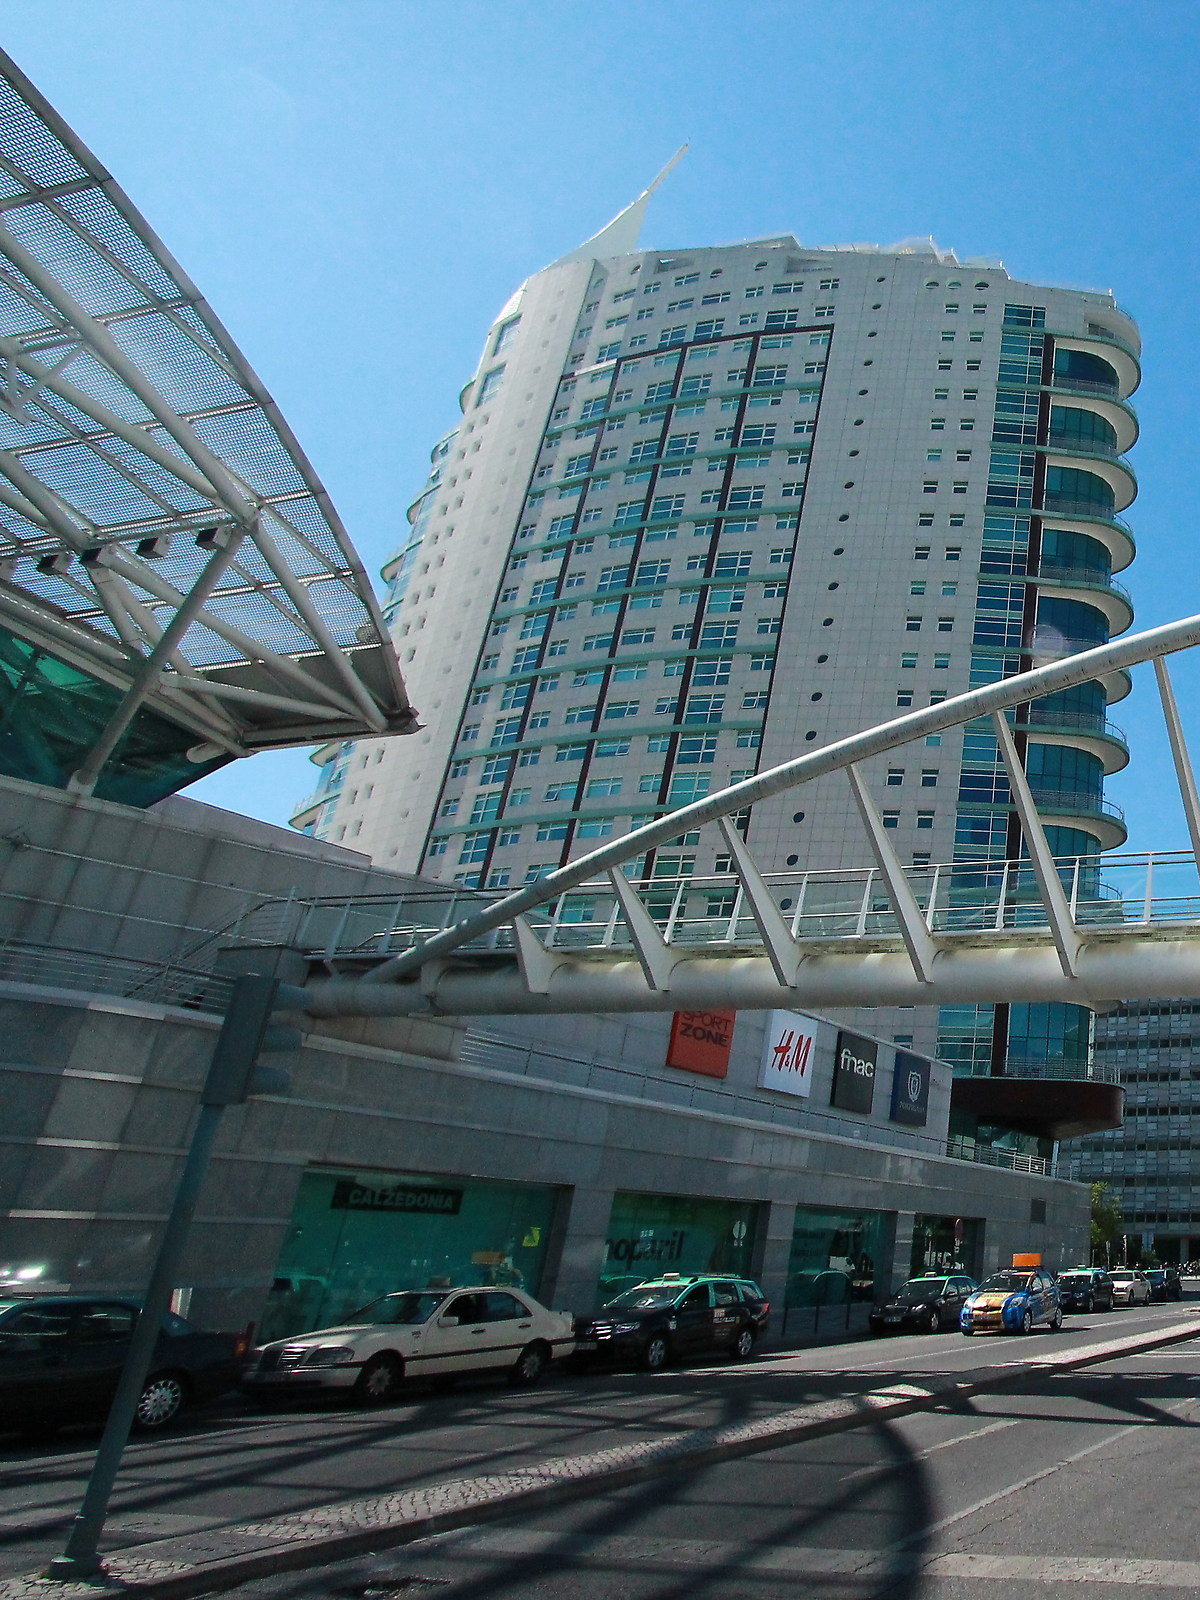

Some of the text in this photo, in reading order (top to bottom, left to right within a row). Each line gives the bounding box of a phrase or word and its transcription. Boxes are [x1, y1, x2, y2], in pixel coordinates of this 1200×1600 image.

[680, 1022, 729, 1048] ZONE
[772, 1028, 812, 1078] H&M
[840, 1048, 874, 1079] fnac
[348, 1188, 454, 1209] CALZEDONIA
